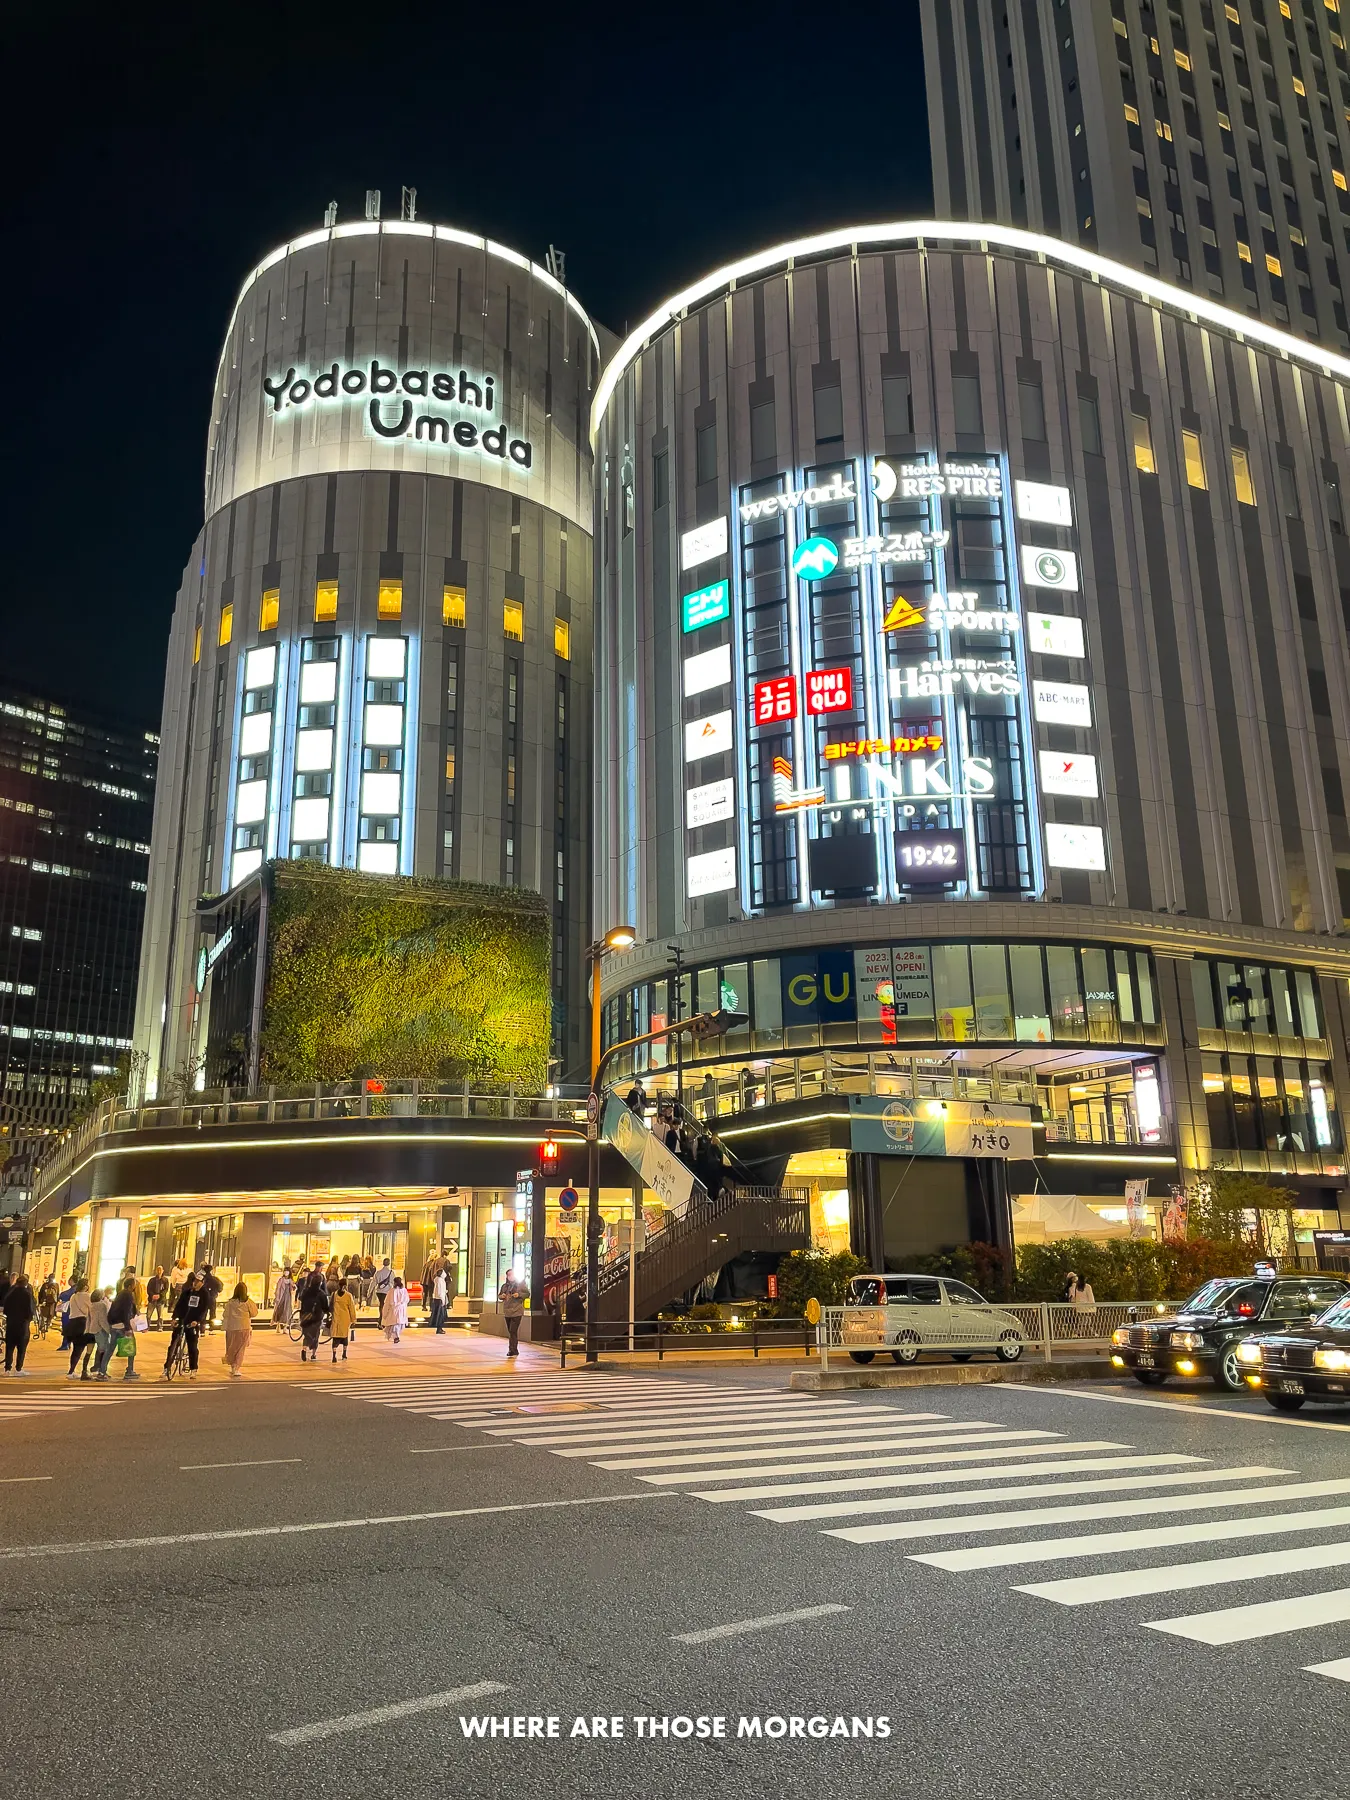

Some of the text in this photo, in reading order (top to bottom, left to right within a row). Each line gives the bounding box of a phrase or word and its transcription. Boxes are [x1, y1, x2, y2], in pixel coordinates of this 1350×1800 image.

[263, 359, 495, 412] Yodobashi
[369, 398, 532, 469] Umeda
[902, 463, 1001, 479] Hotel Hankyu
[739, 472, 857, 521] wework
[877, 549, 927, 564] SPORTS
[688, 585, 724, 615] ニトリ
[928, 591, 979, 611] ART
[928, 610, 1021, 632] SPORTS
[810, 672, 844, 692] UNI
[888, 666, 1022, 698] Harves
[810, 689, 847, 712] QLO
[829, 803, 940, 824] UMEDA
[902, 844, 958, 868] 19:42
[866, 962, 926, 974] NEW OPEN!
[788, 971, 851, 1007] GU
[896, 991, 930, 1000] UMEDA
